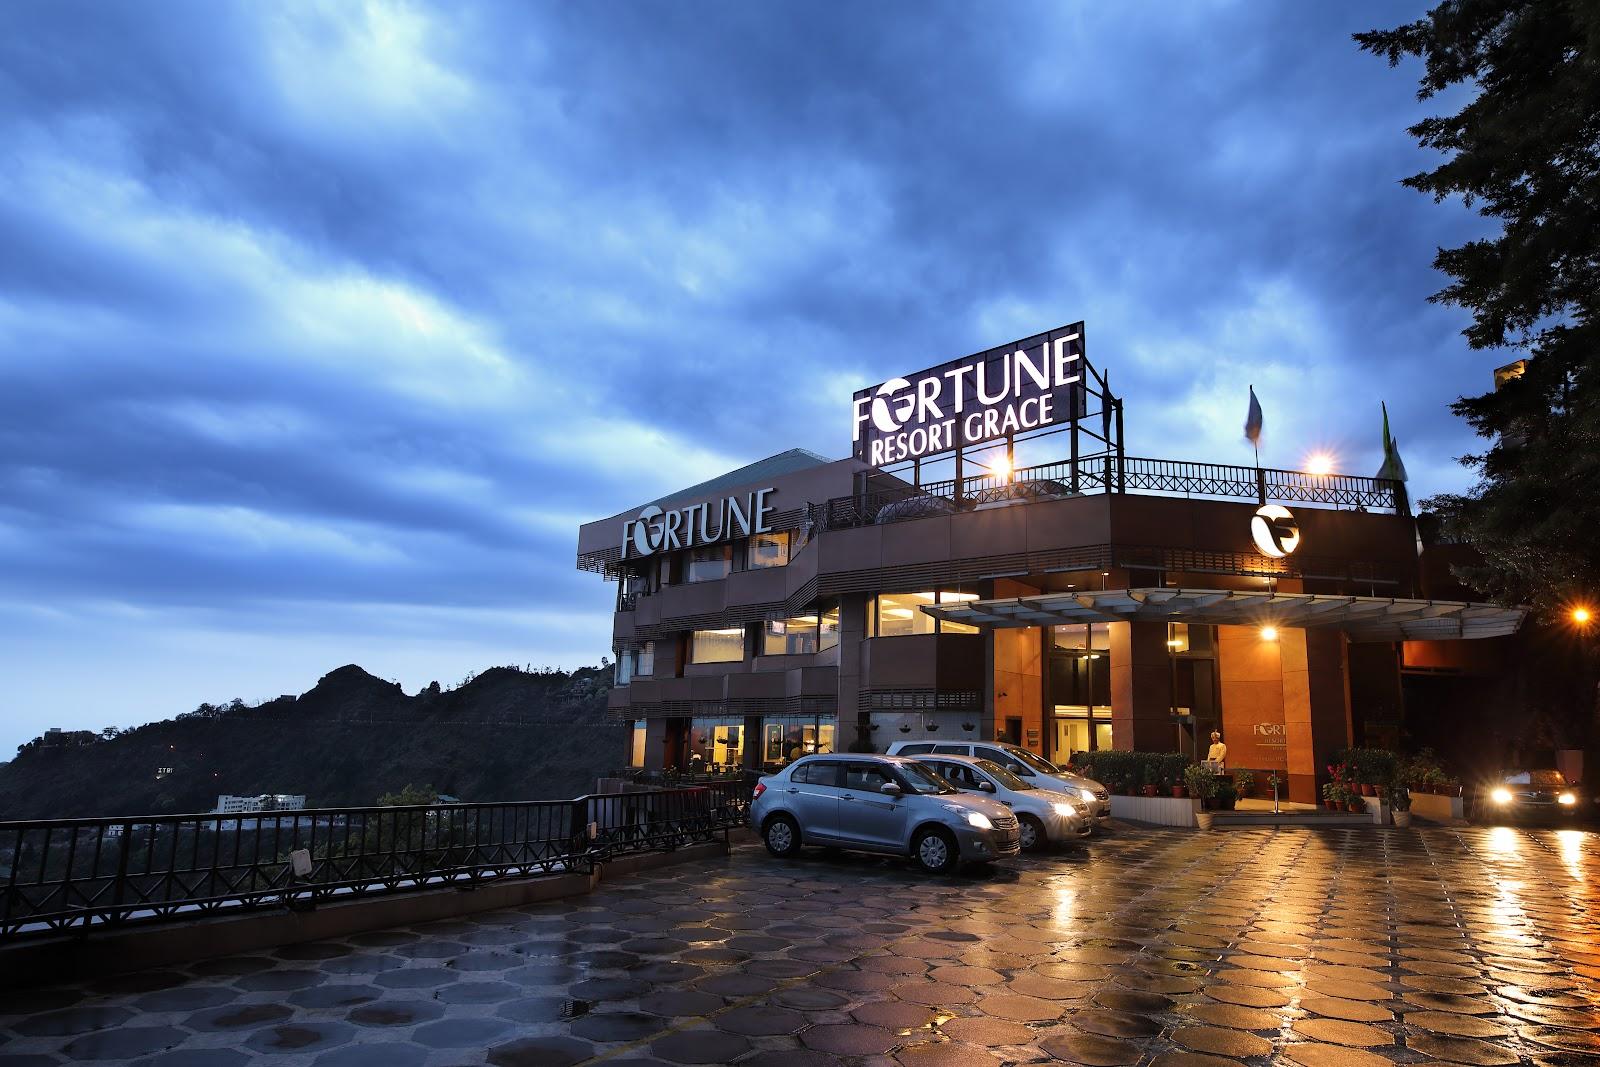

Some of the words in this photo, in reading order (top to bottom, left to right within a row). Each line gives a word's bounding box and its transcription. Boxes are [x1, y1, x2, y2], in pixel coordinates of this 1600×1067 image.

[852, 333, 1081, 442] FORTUNE
[871, 419, 956, 467] RESORT
[964, 393, 1054, 441] GRACE
[621, 487, 775, 559] FORTUNE
